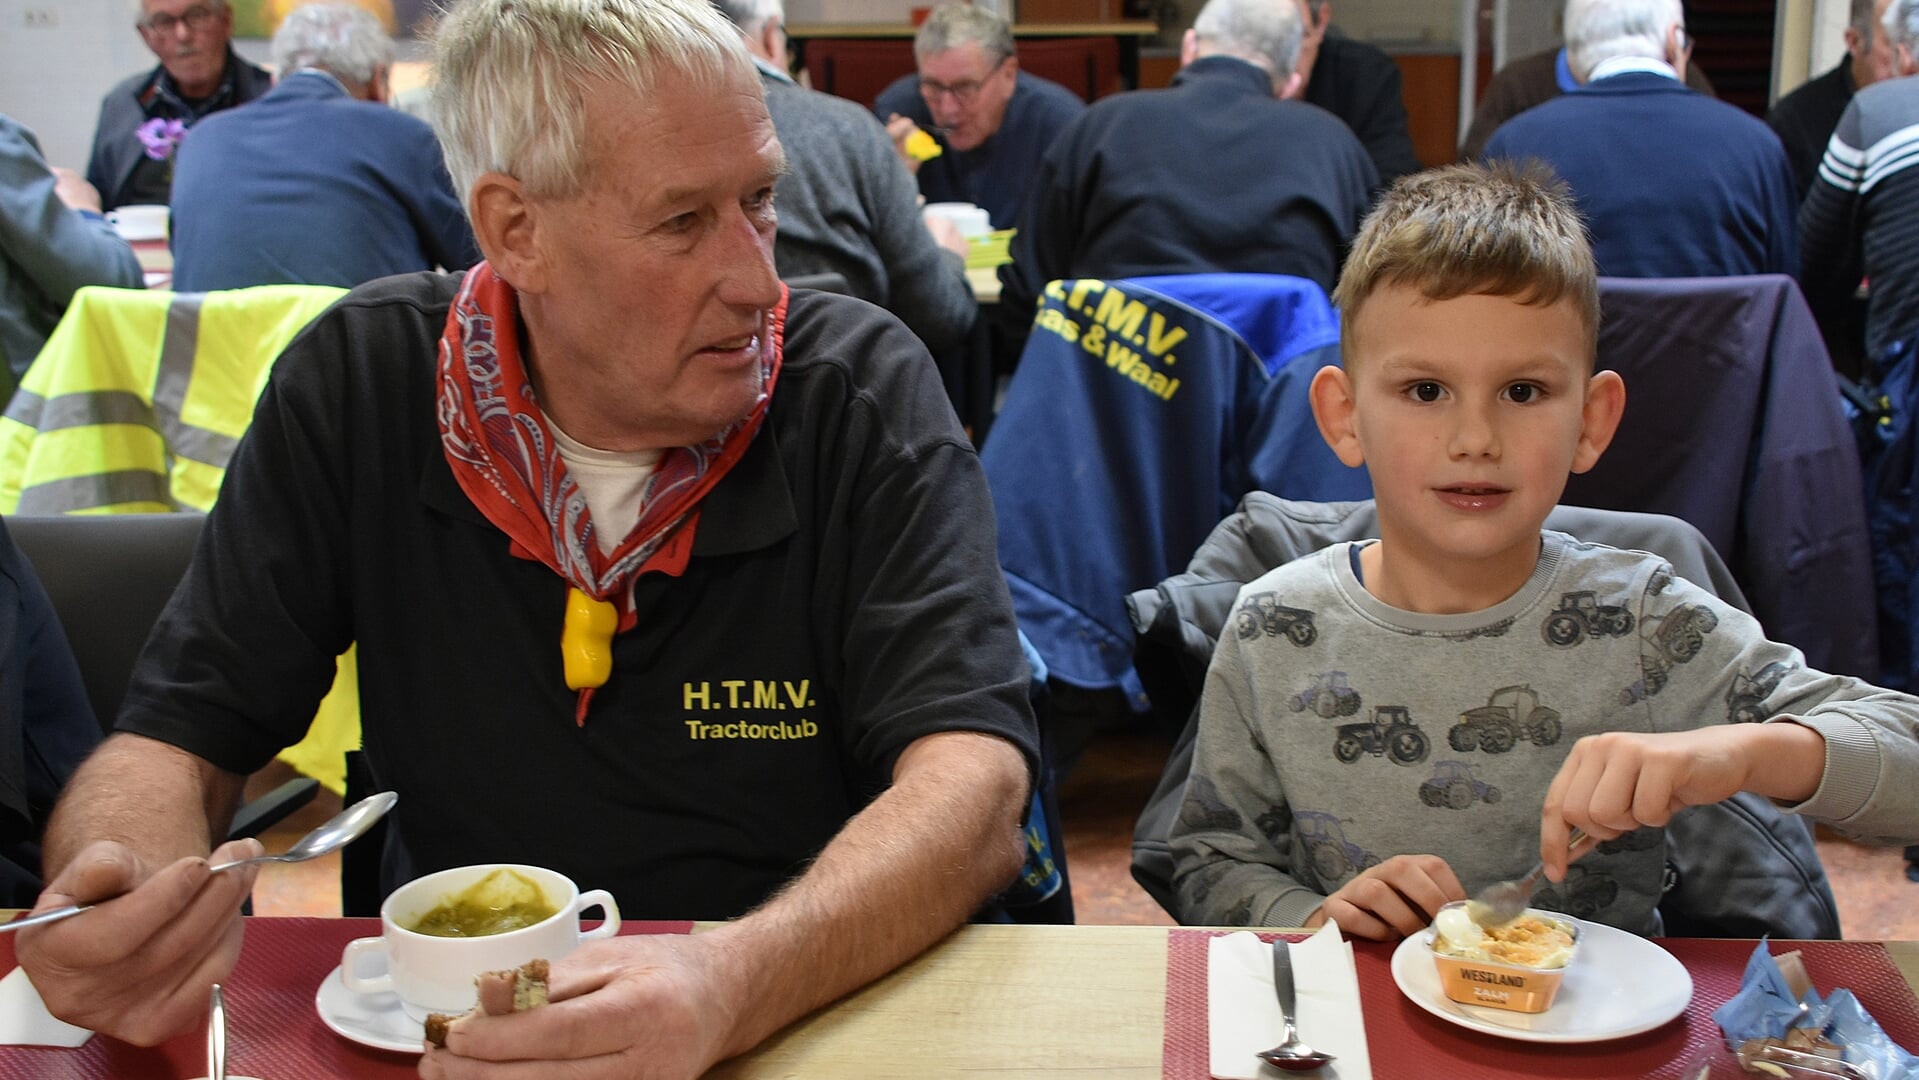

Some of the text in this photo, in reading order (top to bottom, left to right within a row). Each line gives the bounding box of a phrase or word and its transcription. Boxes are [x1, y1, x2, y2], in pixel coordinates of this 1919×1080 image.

[1081, 324, 1107, 358] &
[1105, 340, 1181, 401] Waal
[683, 679, 816, 710] H.T.M.V.
[684, 718, 818, 740] Tractorclub
[1460, 967, 1524, 988] WESTLAND
